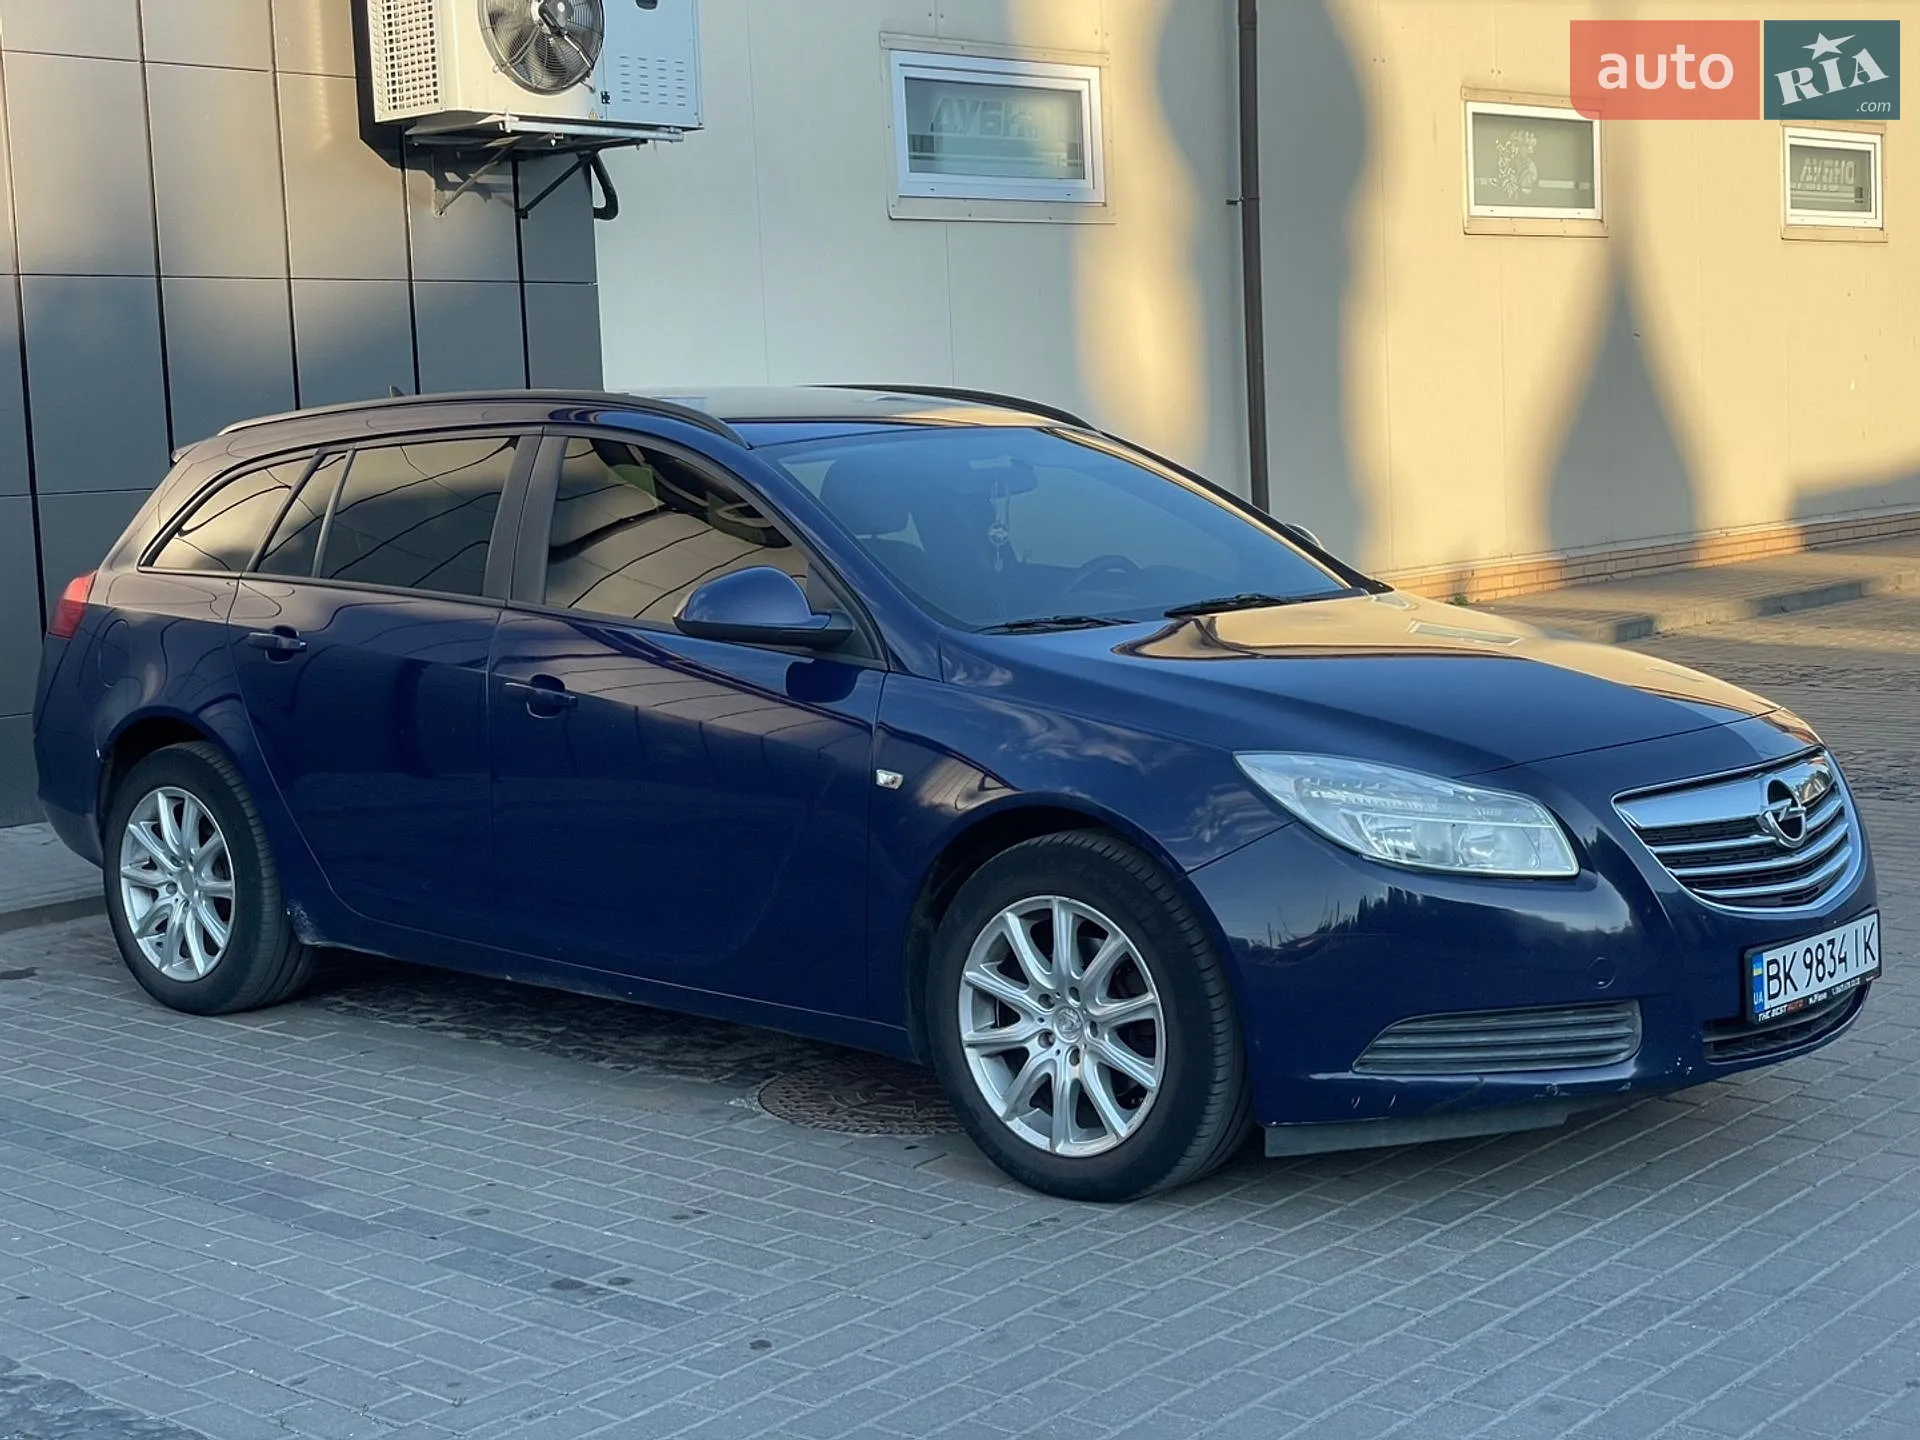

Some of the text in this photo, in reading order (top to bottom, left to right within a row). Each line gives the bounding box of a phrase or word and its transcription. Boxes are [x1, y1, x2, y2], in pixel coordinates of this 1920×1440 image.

[1766, 922, 1876, 1001] BK 9834 IK
[1753, 991, 1764, 1005] UA
